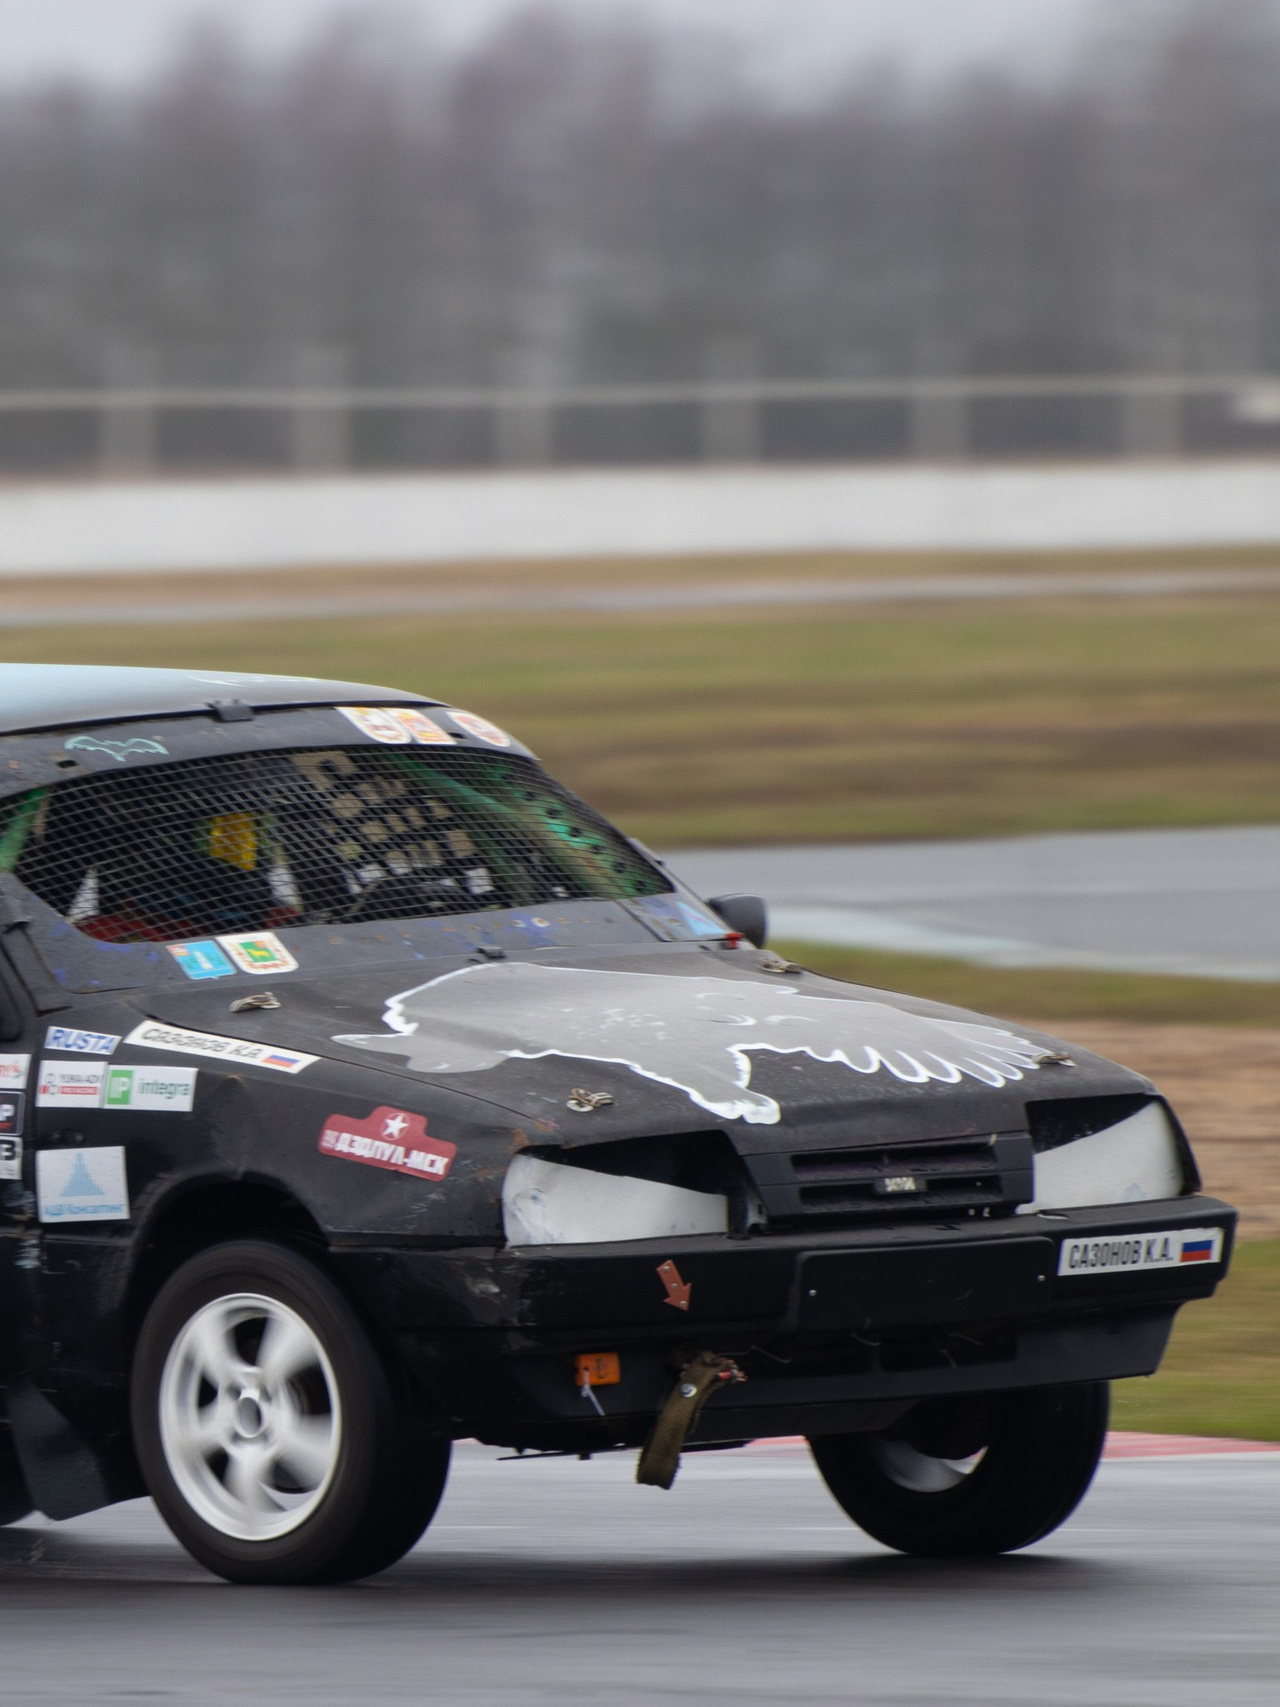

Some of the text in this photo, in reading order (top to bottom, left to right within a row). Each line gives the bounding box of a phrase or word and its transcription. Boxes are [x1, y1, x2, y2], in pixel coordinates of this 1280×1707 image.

[48, 1028, 117, 1053] RUSTA
[138, 1077, 190, 1099] integra
[1069, 1240, 1142, 1269] САЗОНОВ
